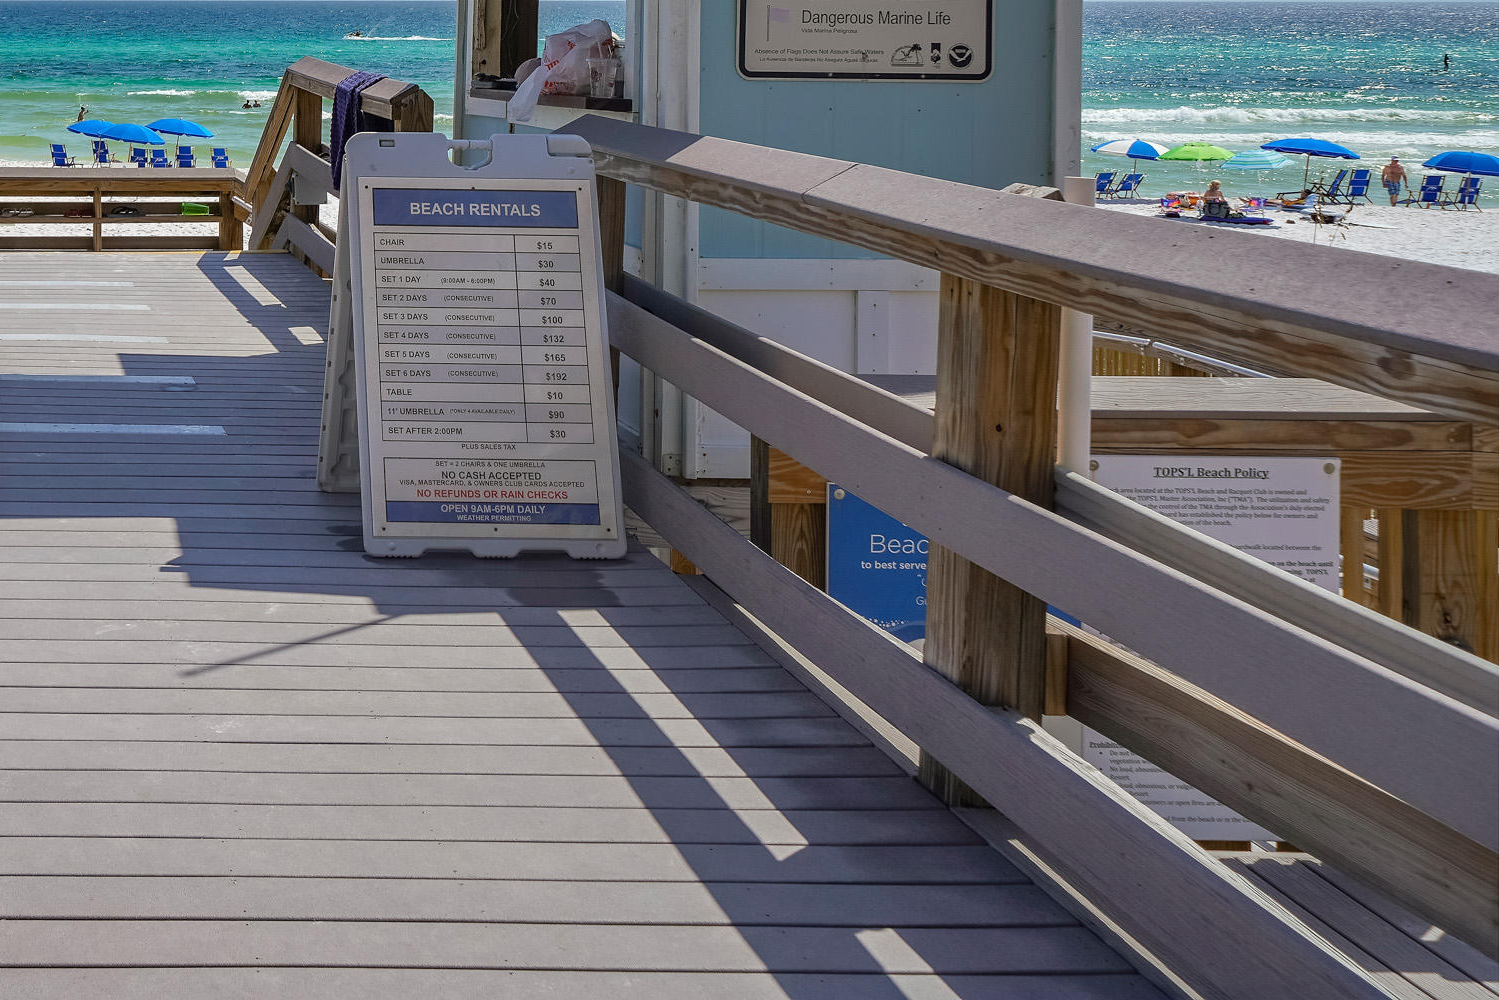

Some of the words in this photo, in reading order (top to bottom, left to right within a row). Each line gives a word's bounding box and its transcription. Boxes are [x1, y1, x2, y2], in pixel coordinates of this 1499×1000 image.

[802, 10, 874, 27] Dangerous
[878, 11, 922, 24] Marine
[928, 11, 950, 25] Life
[410, 203, 464, 216] BEACH
[470, 204, 541, 217] RENTALS
[537, 242, 553, 250] $15
[539, 279, 555, 287] $40
[542, 316, 563, 324] $100
[543, 335, 564, 343] $132
[544, 354, 565, 362] $165
[546, 373, 566, 381] $192
[547, 392, 563, 400] $10
[548, 411, 564, 419] $90
[441, 471, 456, 479] NO
[459, 471, 486, 479] CASH
[489, 472, 541, 480] ACCEPTED
[1153, 467, 1194, 478] TOPS'L
[1197, 468, 1231, 478] Beach
[1235, 468, 1269, 479] Policy
[417, 489, 431, 498] NO
[434, 490, 481, 498] REFUNDS
[483, 490, 498, 498] OR
[501, 490, 524, 499] RAIN
[527, 491, 568, 499] CHECKS
[441, 504, 468, 513] OPEN
[471, 505, 515, 514] 9AM-6PM
[518, 506, 546, 514] DAILY
[870, 534, 929, 554] Beac
[861, 561, 871, 569] to
[875, 561, 896, 569] best
